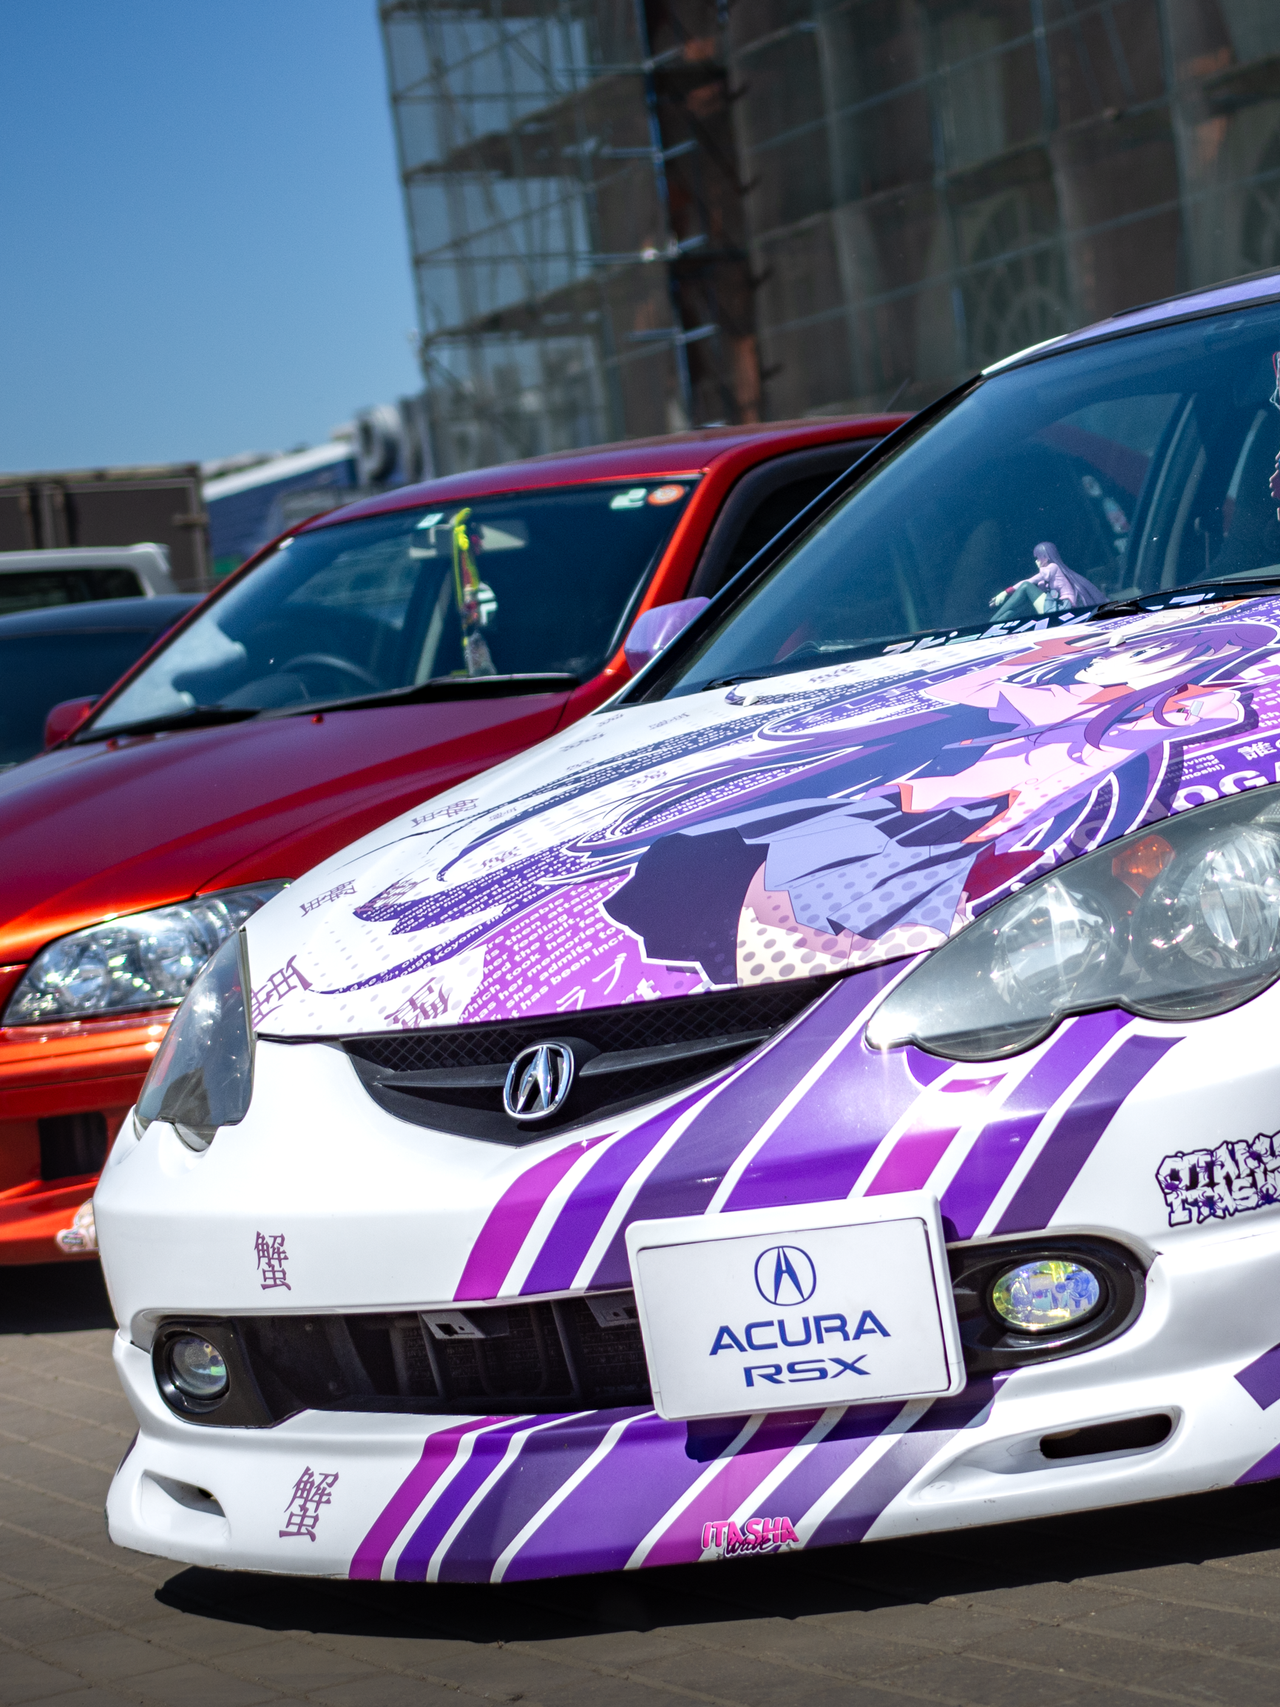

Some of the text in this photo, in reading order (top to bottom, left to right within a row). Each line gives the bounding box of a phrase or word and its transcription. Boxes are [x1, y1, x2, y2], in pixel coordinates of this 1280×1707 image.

[504, 920, 542, 947] then
[509, 899, 565, 934] unable
[569, 885, 588, 897] to
[513, 914, 568, 952] feeling
[573, 891, 604, 914] and
[498, 976, 525, 1001] her
[526, 921, 606, 978] memories
[505, 952, 542, 981] took
[545, 929, 574, 951] her
[505, 926, 617, 1009] she admits to
[513, 942, 541, 963] the
[519, 985, 550, 1010] has
[550, 955, 592, 986] been
[252, 1231, 292, 1291] 蟹
[709, 1309, 892, 1356] ACURA
[744, 1352, 872, 1388] RSX
[278, 1465, 342, 1543] 蟹
[703, 1517, 799, 1549] ITASHA
